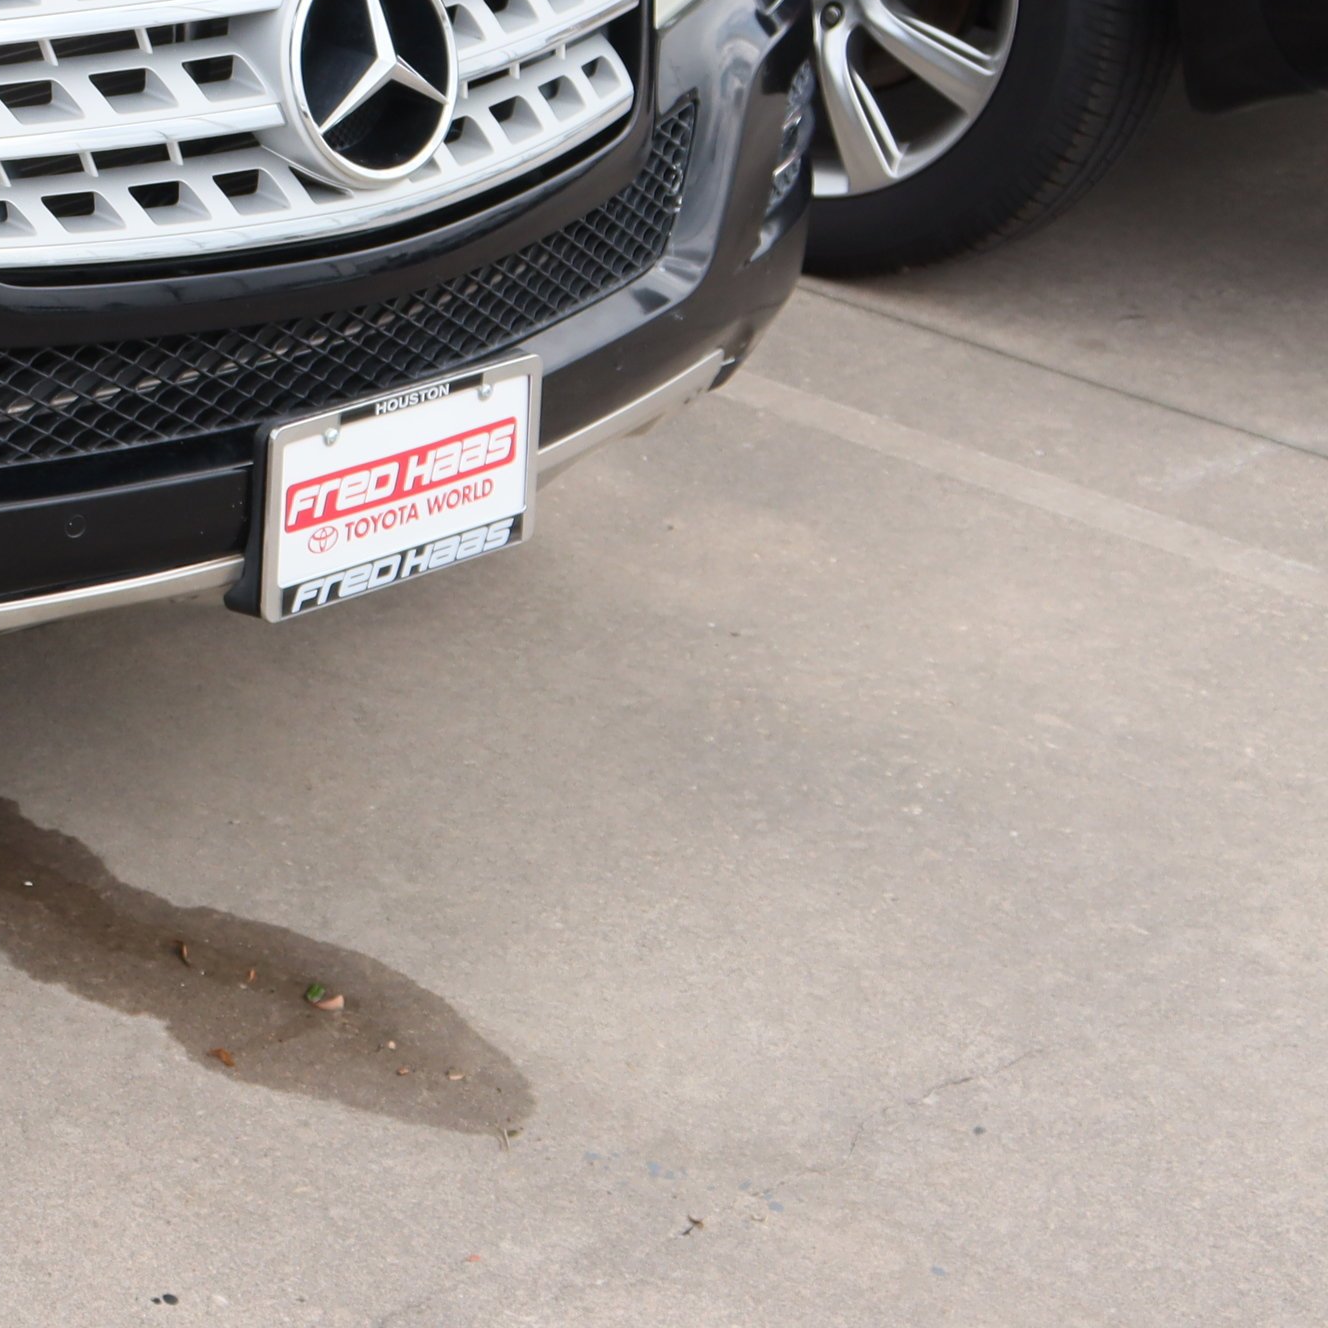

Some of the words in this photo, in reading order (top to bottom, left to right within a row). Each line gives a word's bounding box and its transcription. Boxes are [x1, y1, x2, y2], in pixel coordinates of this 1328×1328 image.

[374, 382, 451, 416] HOUSTON
[344, 506, 420, 542] TOYOTA
[426, 477, 494, 517] WORLD
